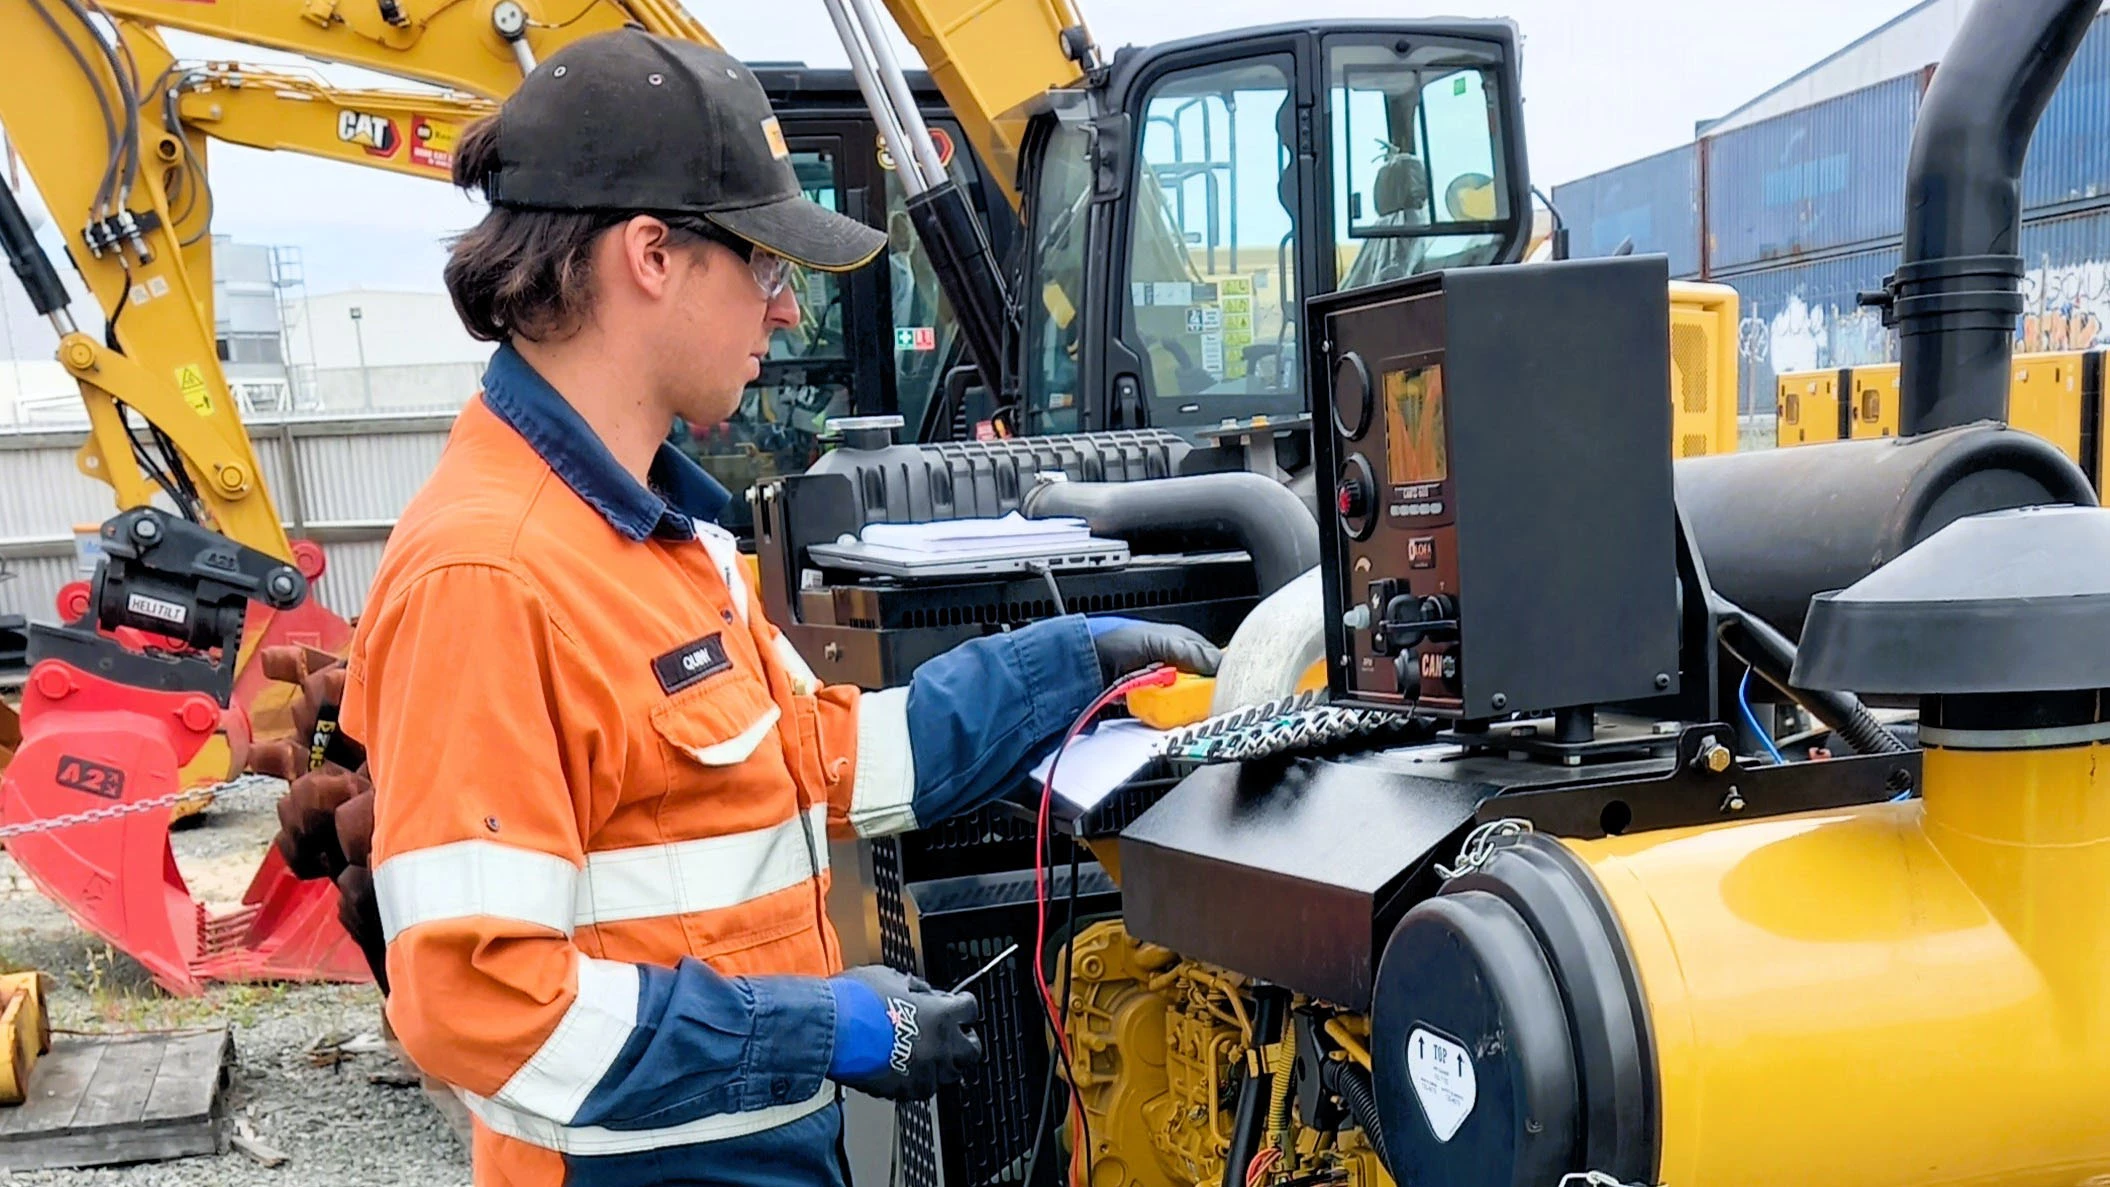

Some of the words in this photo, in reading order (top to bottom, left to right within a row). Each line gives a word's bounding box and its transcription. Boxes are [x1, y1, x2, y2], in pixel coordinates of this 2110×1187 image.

[338, 110, 388, 149] CAT
[1422, 654, 1443, 678] CAN
[888, 996, 919, 1073] NINJA
[1433, 1044, 1448, 1064] TOP
